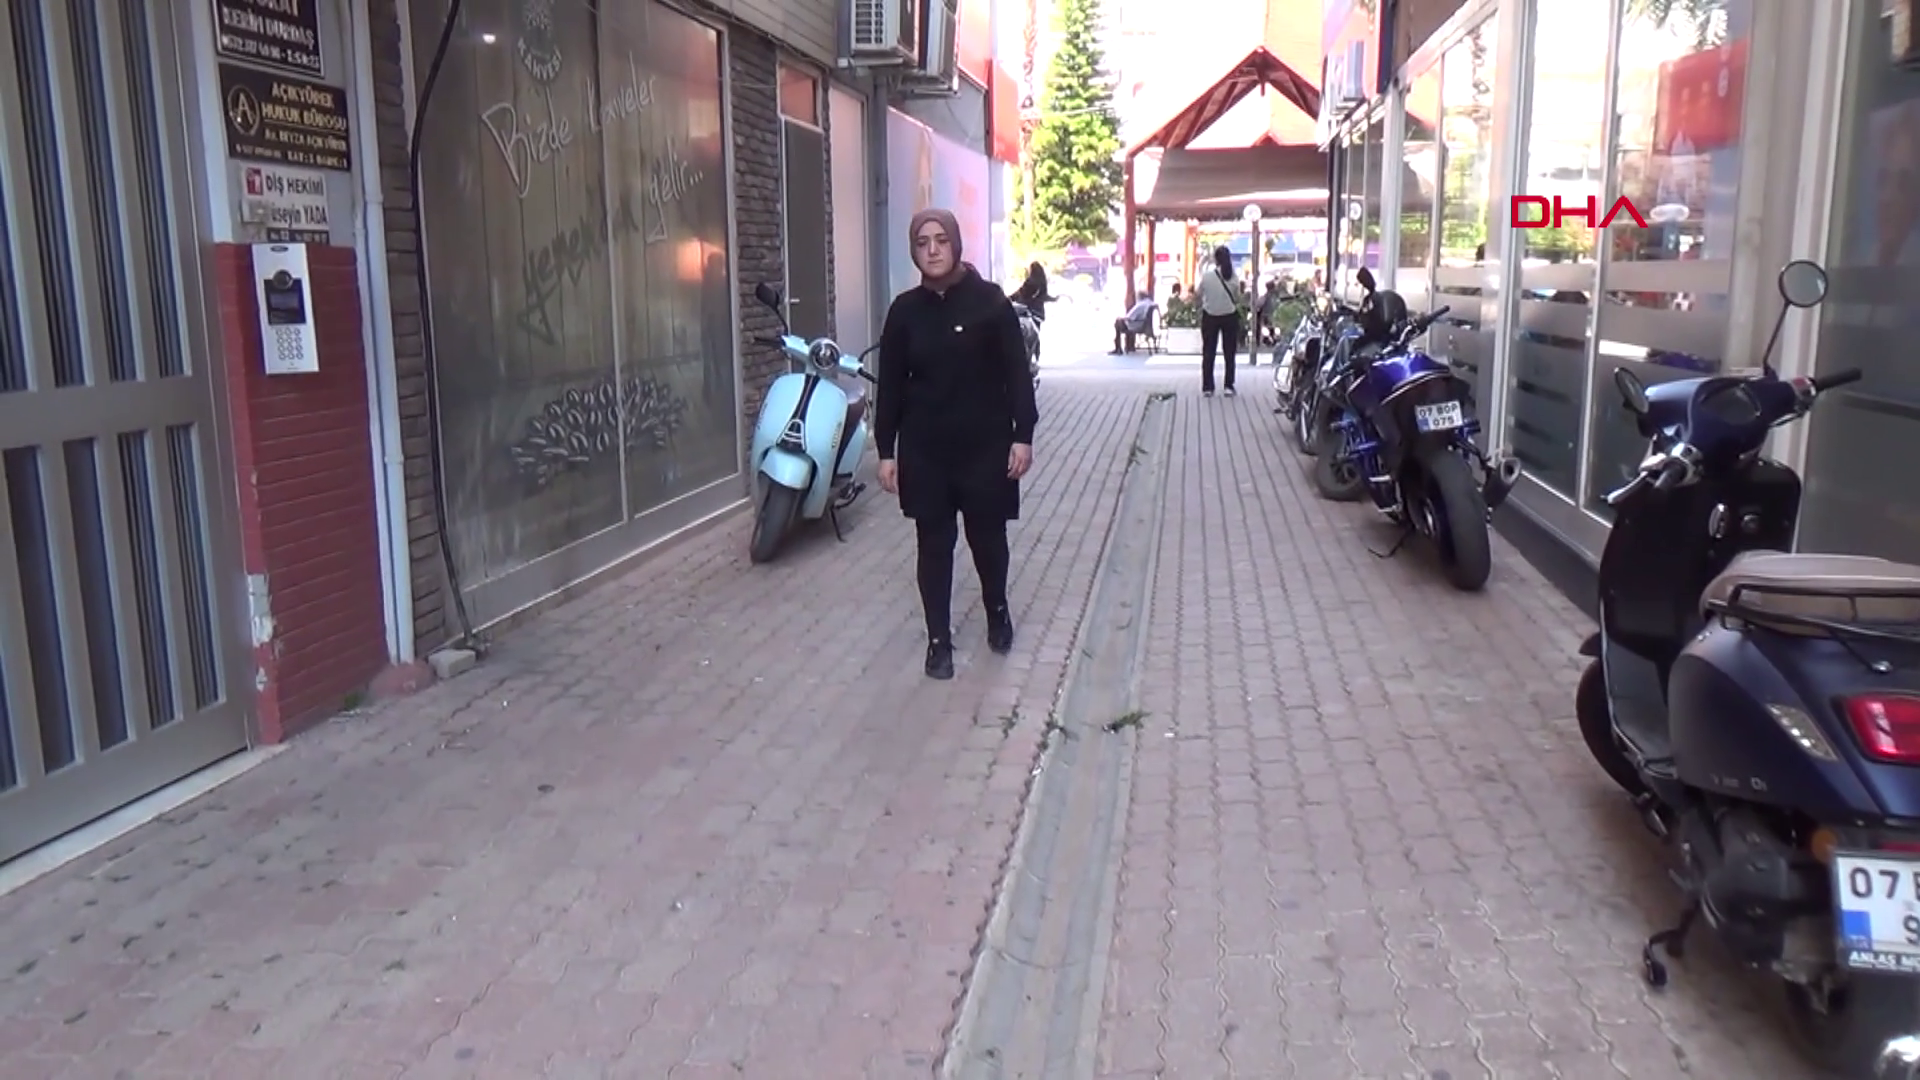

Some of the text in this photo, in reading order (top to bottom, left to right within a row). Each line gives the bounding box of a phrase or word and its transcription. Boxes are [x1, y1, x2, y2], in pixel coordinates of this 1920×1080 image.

[261, 102, 347, 132] HUKUK BÜROSU
[482, 86, 573, 198] Bizde
[265, 172, 324, 197] DİŞ HEKİMİ
[302, 204, 328, 225] YADA
[1849, 867, 1900, 899] 07
